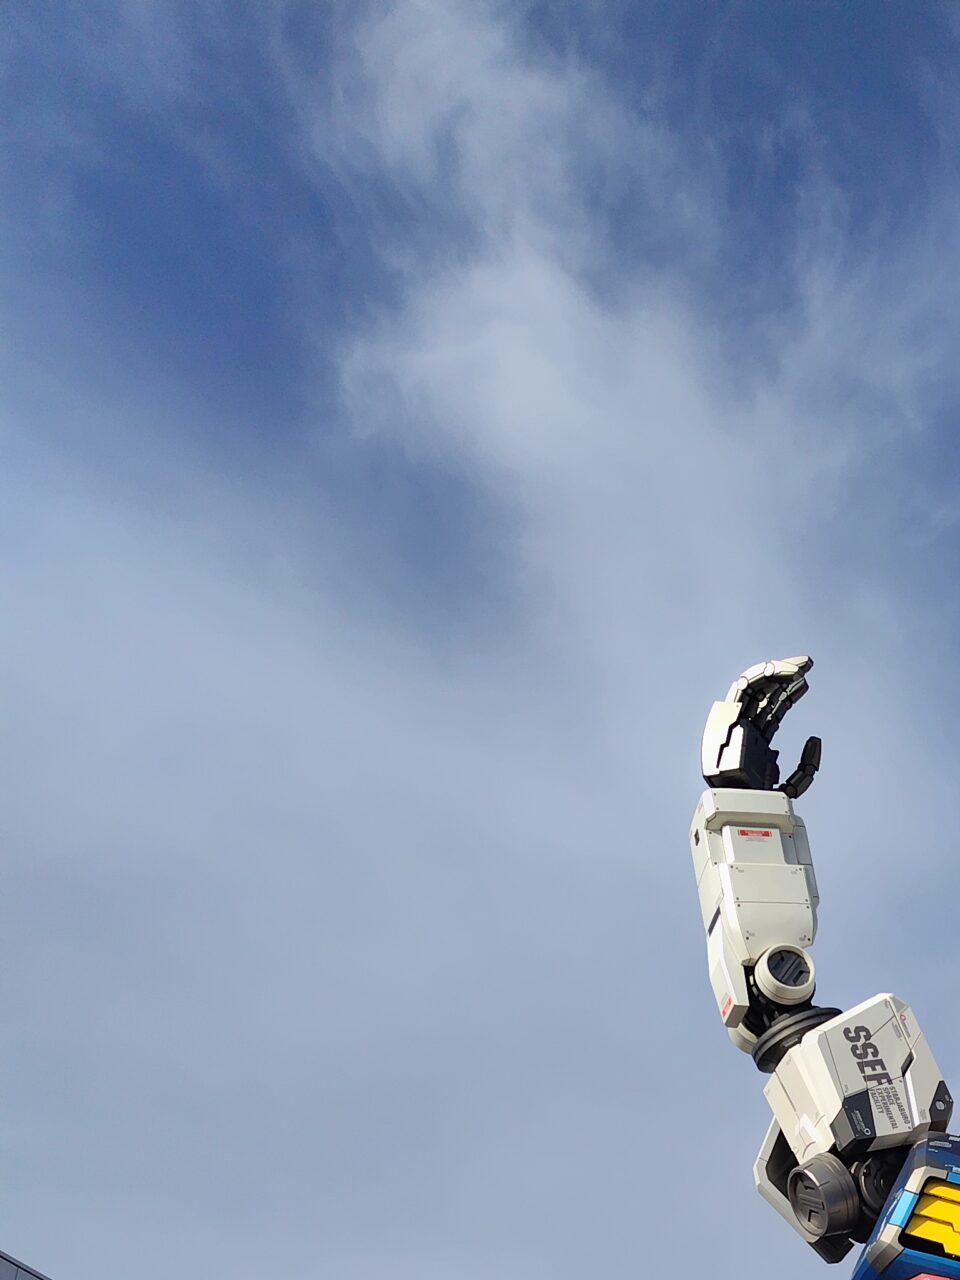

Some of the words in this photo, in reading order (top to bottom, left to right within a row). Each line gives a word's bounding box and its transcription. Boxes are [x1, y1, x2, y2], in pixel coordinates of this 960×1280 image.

[843, 1025, 893, 1086] SSEF
[875, 1087, 899, 1130] EXPERIMENTAL
[882, 1087, 895, 1106] SPACE
